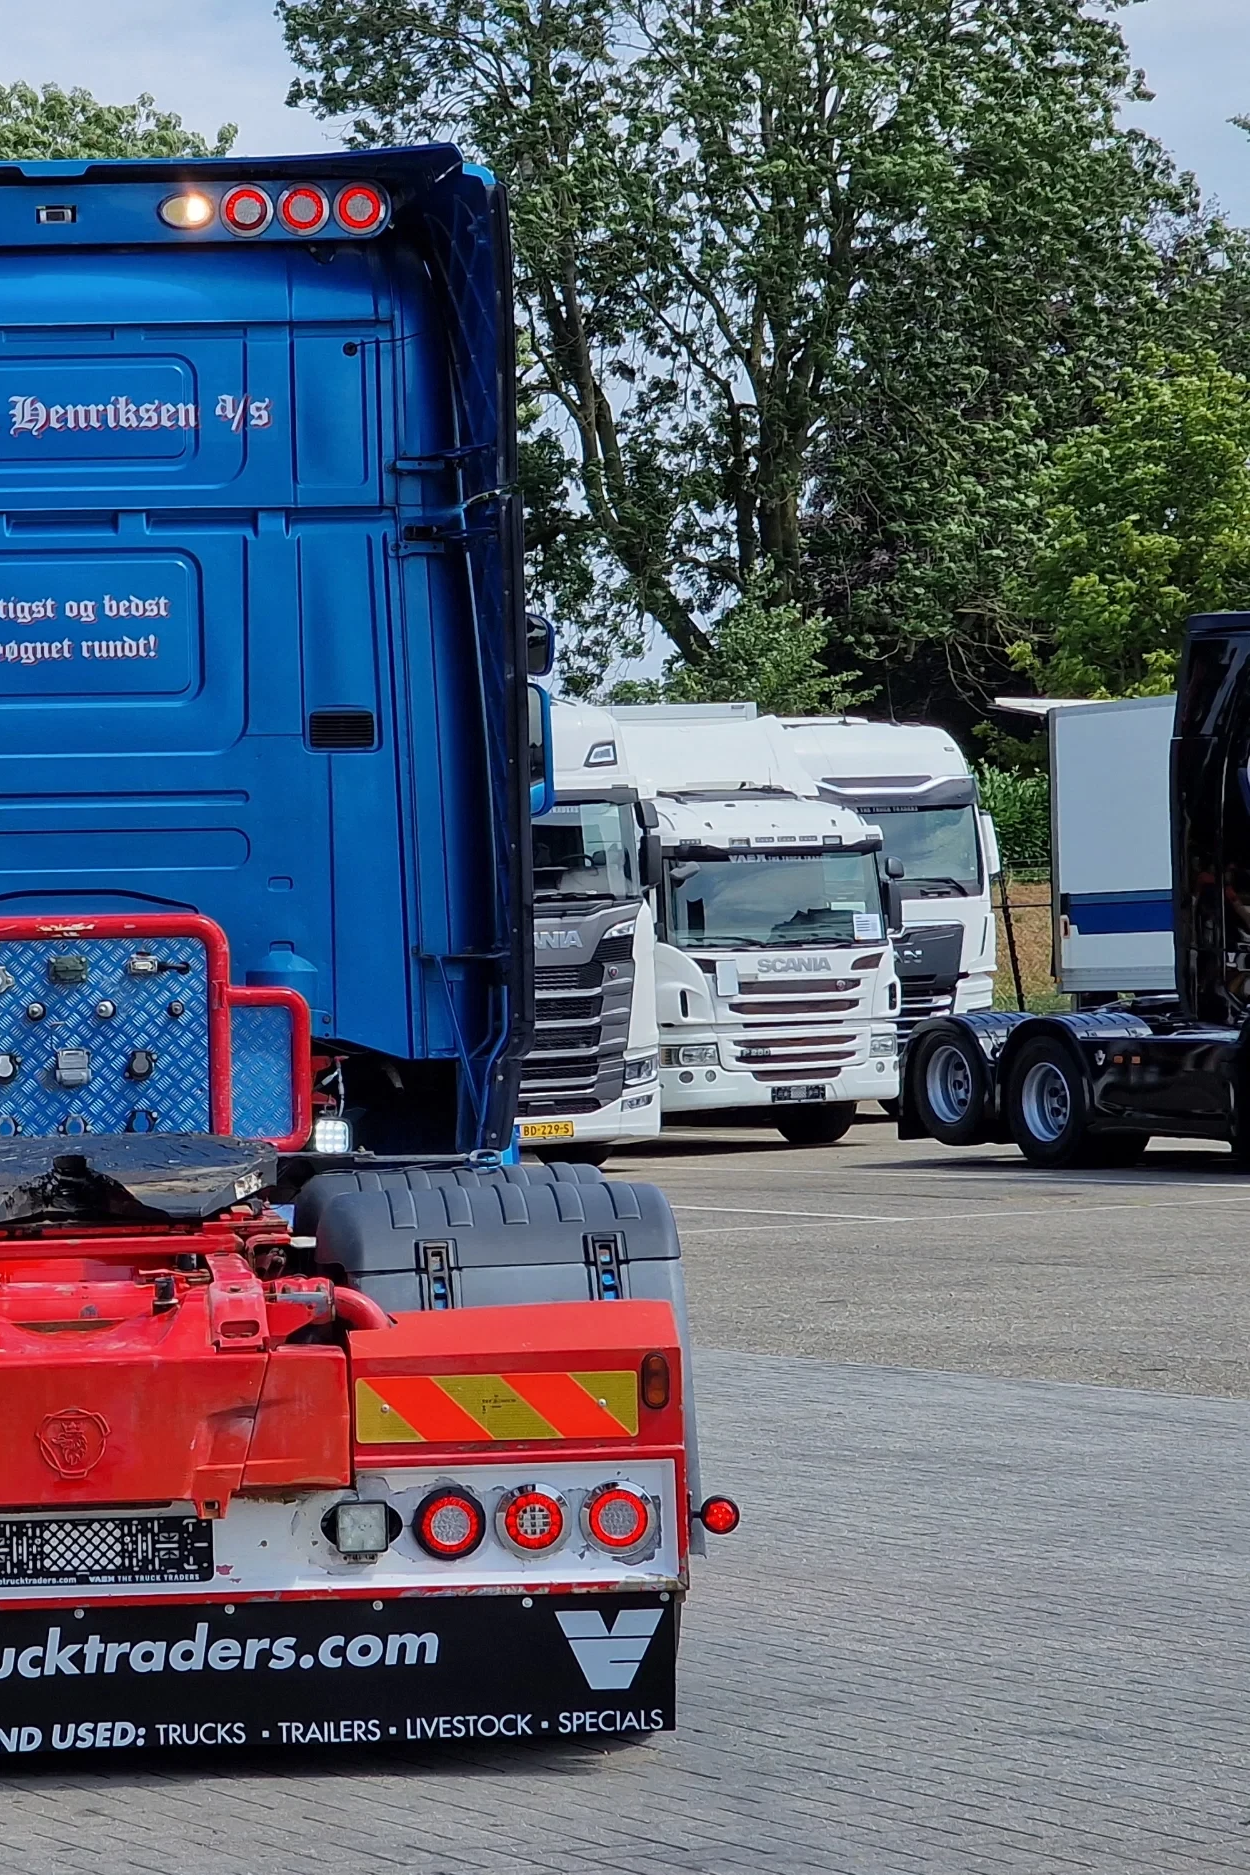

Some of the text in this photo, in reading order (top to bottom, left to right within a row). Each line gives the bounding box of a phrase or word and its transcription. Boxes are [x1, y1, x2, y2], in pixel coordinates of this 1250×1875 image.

[7, 395, 200, 438] Henriksen
[215, 394, 273, 434] a/s
[65, 599, 98, 625] og
[103, 594, 170, 620] bedst
[80, 634, 159, 660] rundt!
[757, 957, 832, 974] SCANIA
[523, 1123, 570, 1137] BD-229-S
[117, 1575, 132, 1583] THE
[135, 1574, 161, 1582] TRUCK
[163, 1573, 200, 1582] TRADERS
[51, 1721, 147, 1751] USED:
[154, 1722, 247, 1746] TRUCKS
[277, 1719, 382, 1744] TRAILERS
[406, 1713, 534, 1741] LIVESTOCK
[557, 1708, 664, 1733] SPECIALS
